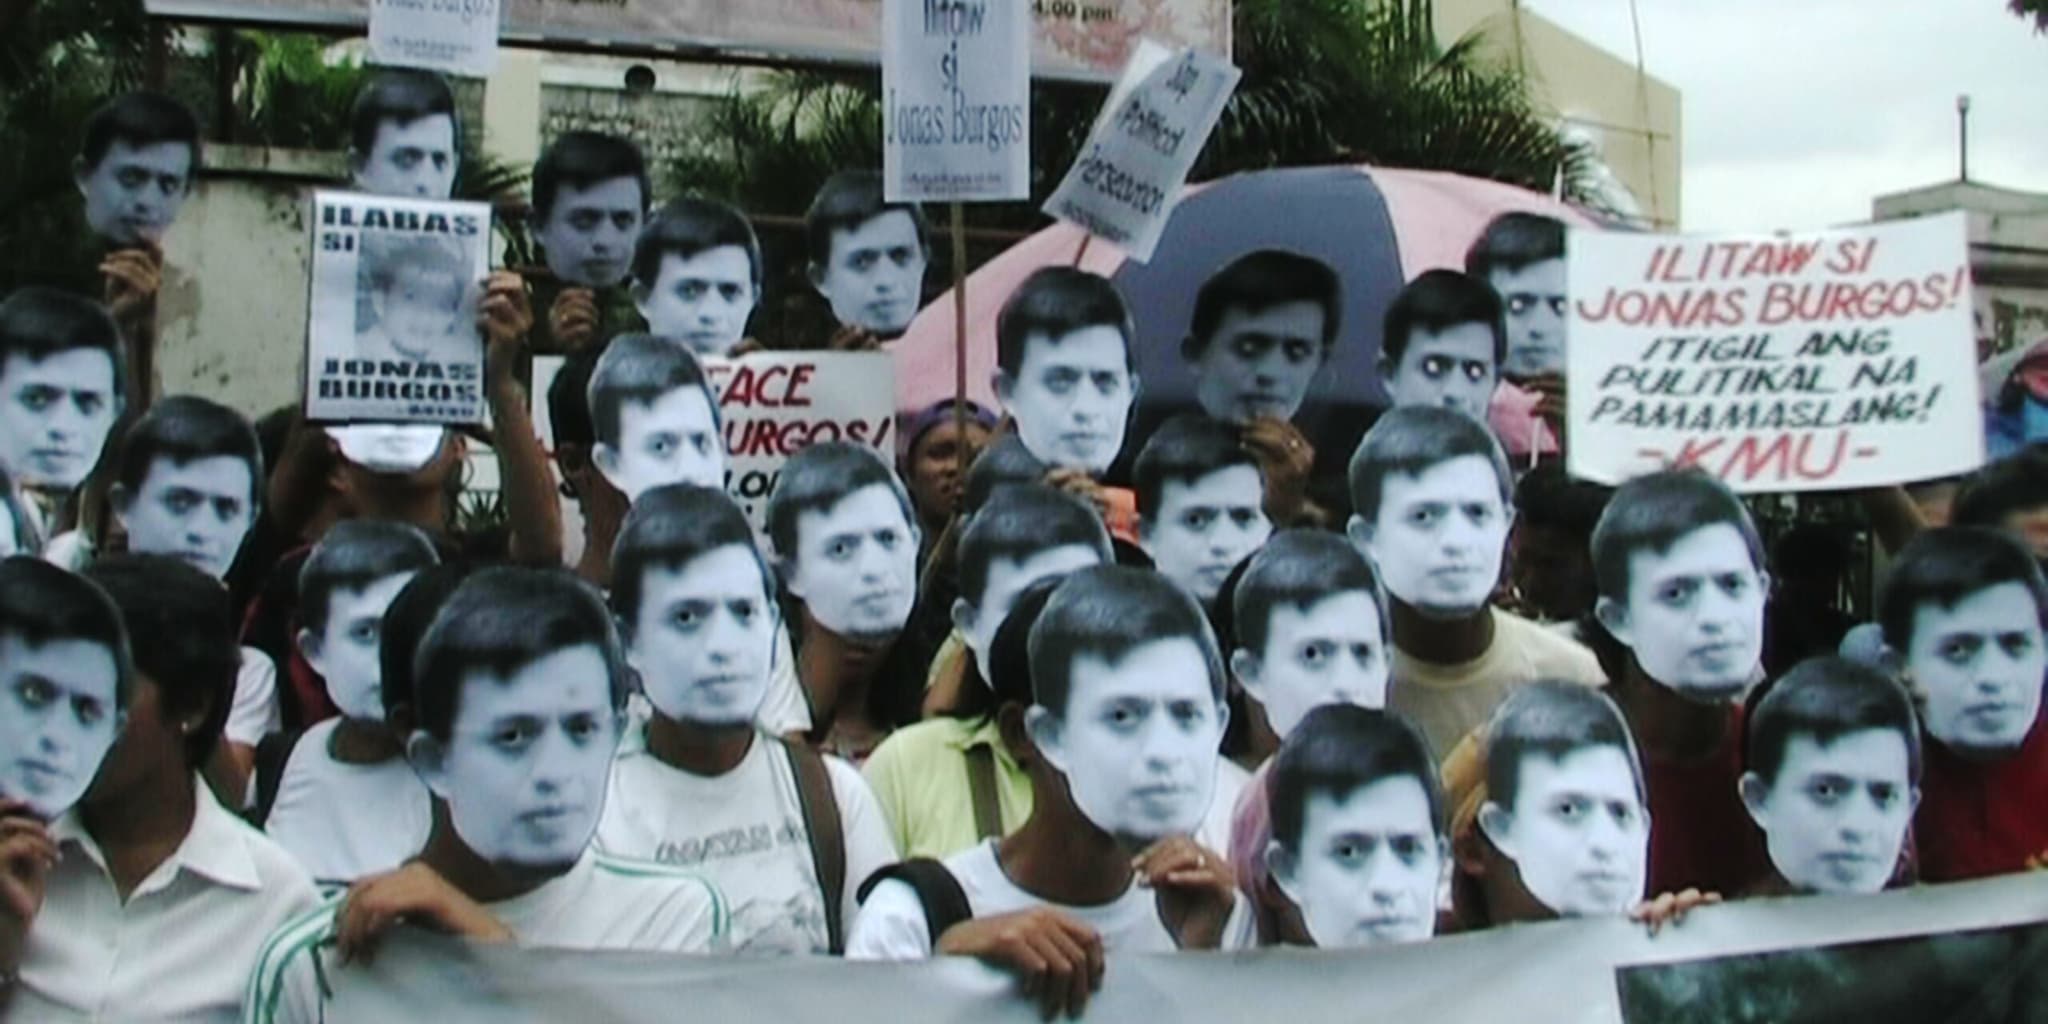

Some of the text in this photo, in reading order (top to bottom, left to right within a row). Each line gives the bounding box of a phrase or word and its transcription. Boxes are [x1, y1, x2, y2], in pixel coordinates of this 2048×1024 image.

[887, 89, 1023, 152] Jonas Burgos
[322, 205, 479, 236] ILABAS
[322, 232, 355, 252] SI
[1643, 237, 1878, 282] ILITAW SI
[1575, 267, 1967, 329] JONAS BURGOS!
[1640, 327, 1894, 363] ITIGIL ANG
[325, 358, 479, 381] JONAS
[1596, 355, 1920, 396] PULITIKAL NA
[318, 379, 479, 404] BURGOS
[1588, 383, 1944, 432] PAMAMASLANG!
